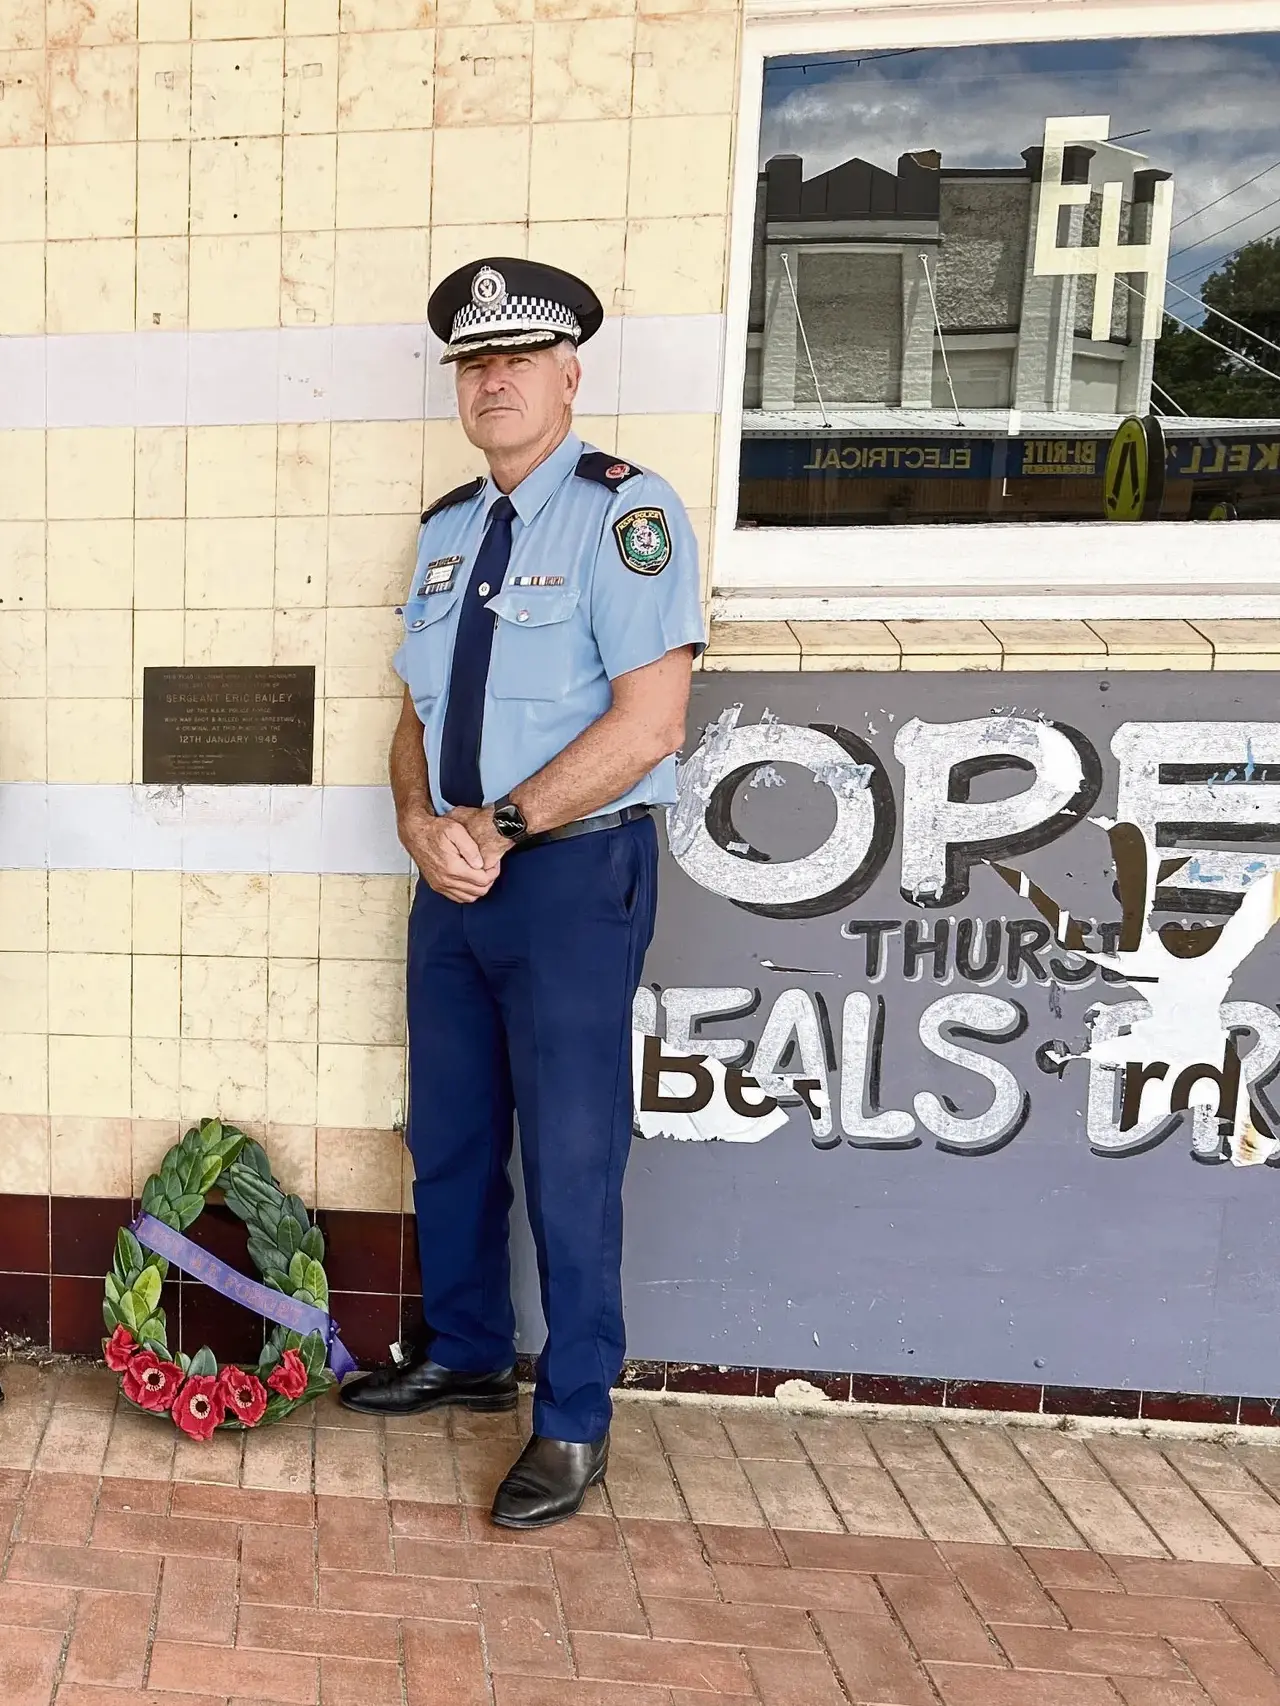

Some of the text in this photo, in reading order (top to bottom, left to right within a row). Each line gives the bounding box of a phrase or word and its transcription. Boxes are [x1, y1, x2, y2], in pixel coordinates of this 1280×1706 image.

[166, 693, 293, 703] SERGEANT ERIC BAILEY
[179, 735, 201, 744] 12TH
[205, 735, 249, 744] JANUARY
[632, 986, 1031, 1157] EALS
